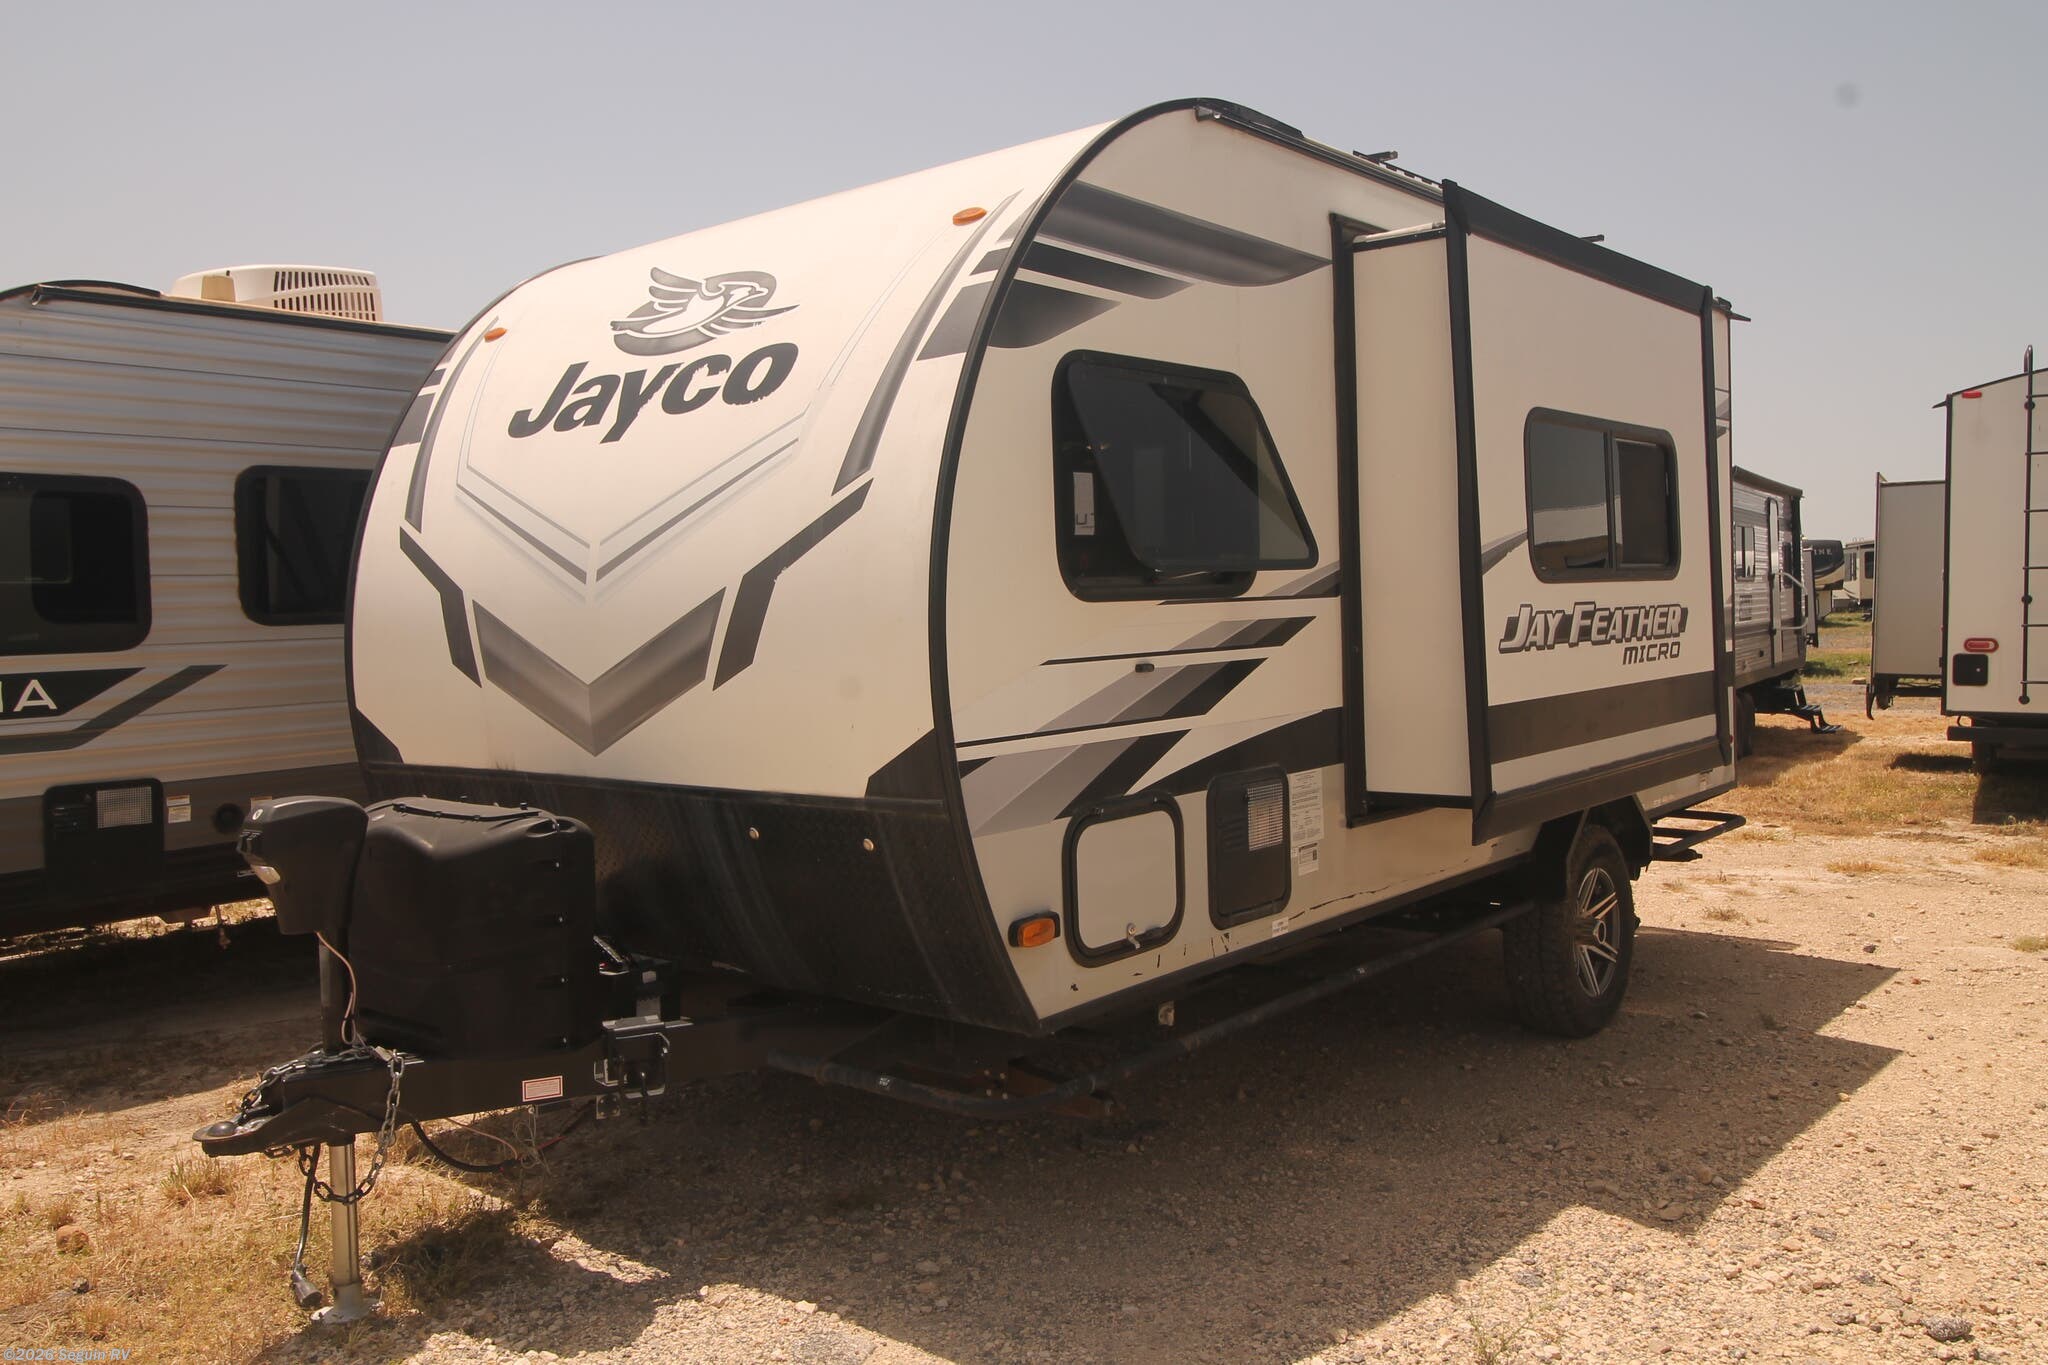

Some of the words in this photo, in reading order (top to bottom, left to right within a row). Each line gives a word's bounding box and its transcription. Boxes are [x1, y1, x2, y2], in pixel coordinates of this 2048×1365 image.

[507, 342, 799, 444] Jayco
[1499, 604, 1565, 653] JAY
[1569, 601, 1683, 648] FEATHER
[1622, 641, 1681, 665] MICRO
